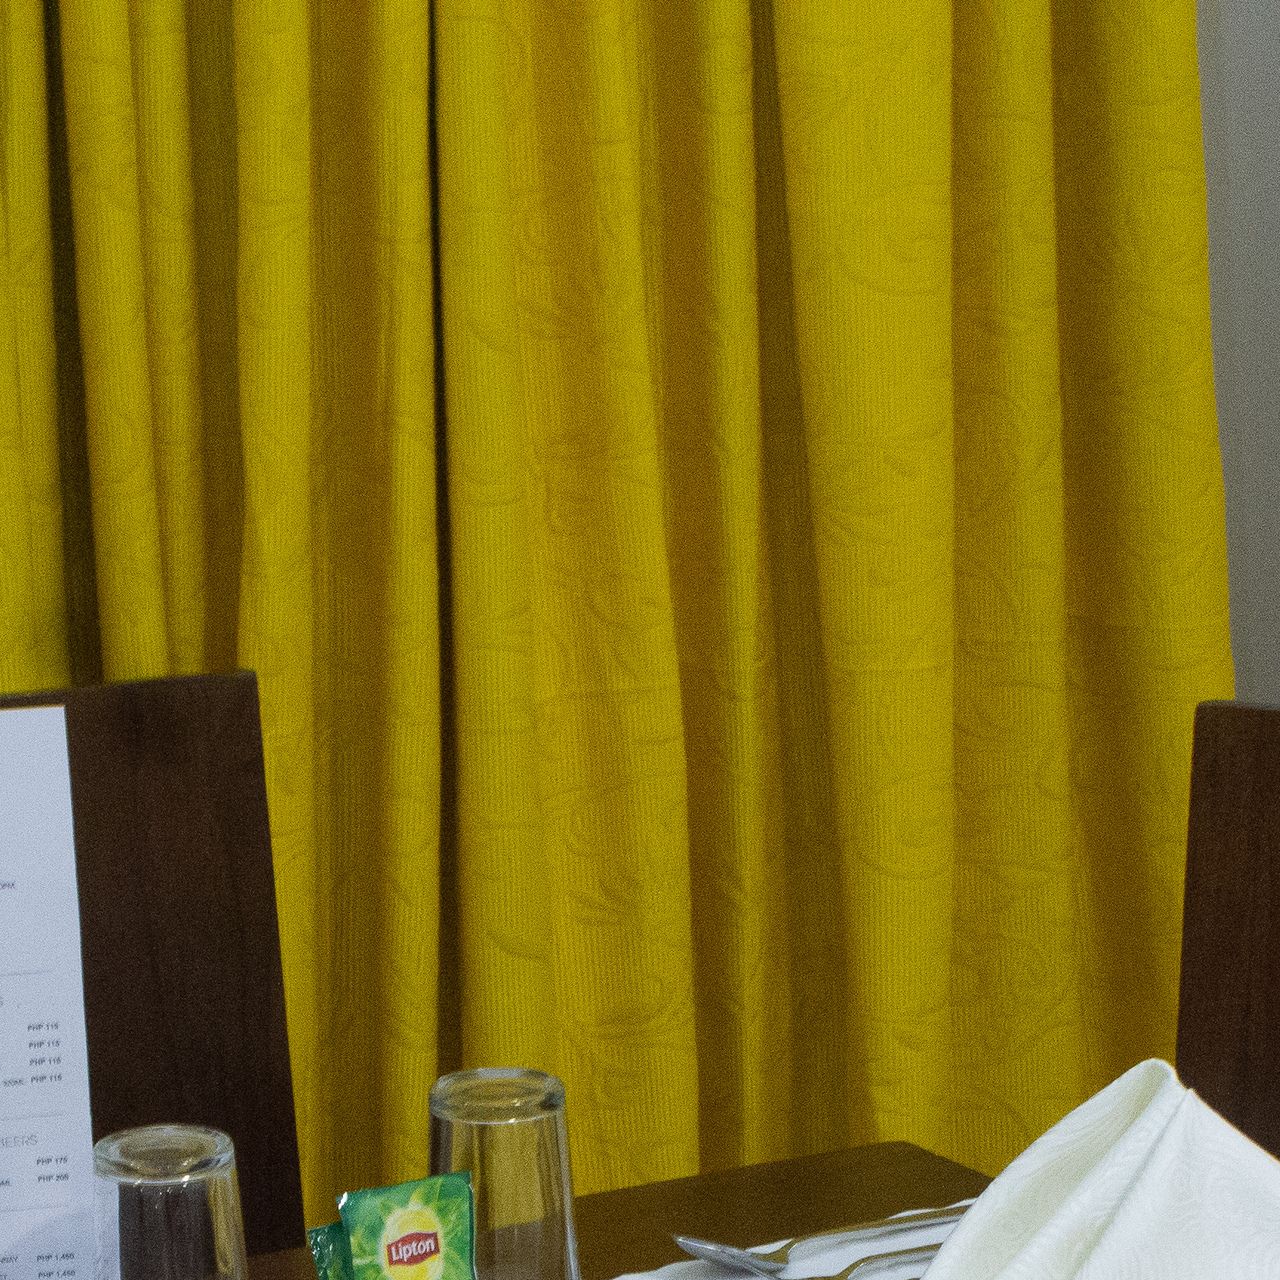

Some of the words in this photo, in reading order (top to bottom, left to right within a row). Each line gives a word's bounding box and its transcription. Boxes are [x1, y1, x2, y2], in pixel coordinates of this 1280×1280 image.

[27, 1023, 43, 1031] PHP
[46, 1021, 59, 1030] 115
[28, 1040, 45, 1049] PHP
[47, 1039, 61, 1048] 115
[29, 1057, 46, 1066] PHP
[48, 1056, 62, 1065] 115
[30, 1075, 47, 1084] PHP
[49, 1073, 63, 1082] 115
[36, 1157, 52, 1165] PHP
[37, 1174, 53, 1183] PHP
[391, 1237, 435, 1262] Lipton
[36, 1254, 52, 1263] PHP
[38, 1271, 54, 1279] PHP
